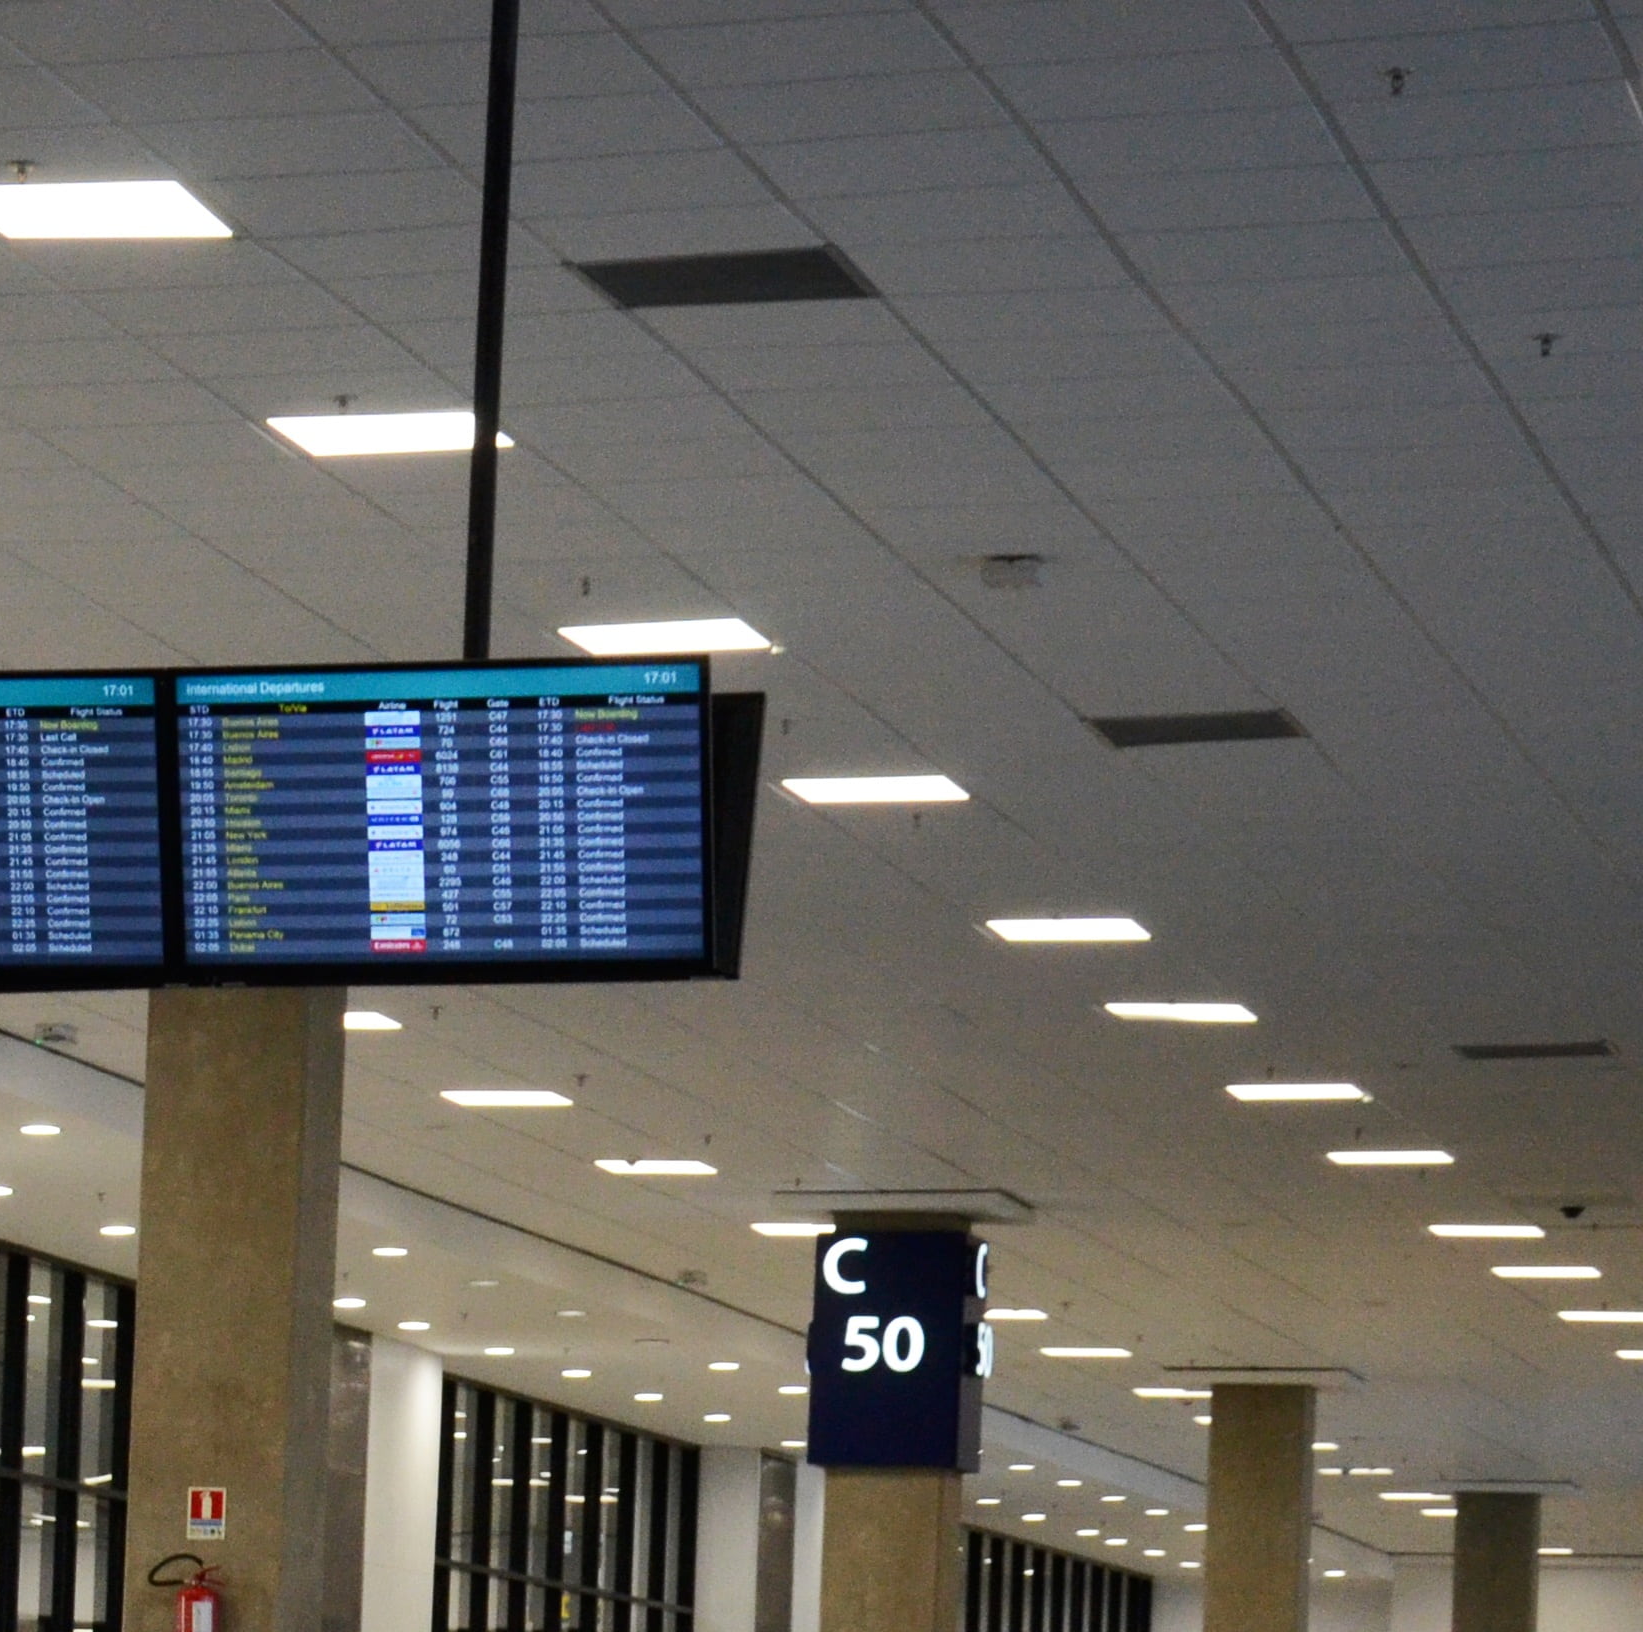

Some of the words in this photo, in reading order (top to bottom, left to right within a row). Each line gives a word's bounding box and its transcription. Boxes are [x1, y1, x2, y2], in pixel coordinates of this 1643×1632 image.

[643, 670, 677, 684] 17:01
[103, 684, 134, 697] 17:01
[186, 682, 257, 697] International
[259, 680, 325, 698] Departures
[487, 698, 509, 708] Gate
[539, 698, 560, 707] ETD
[607, 695, 633, 706] Flight
[635, 694, 665, 704] Status
[189, 704, 209, 714] STD
[379, 701, 407, 711] Airline
[433, 700, 459, 712] Flight
[5, 708, 25, 717] ETD
[70, 707, 93, 718] Flight
[95, 707, 123, 716] Status
[575, 709, 596, 719] Now
[40, 720, 59, 731] Now
[40, 732, 59, 743] Last
[61, 732, 77, 743] Call
[575, 734, 615, 745] Check-in
[617, 733, 649, 744] Closed
[41, 745, 78, 755] Check-in
[80, 744, 109, 755] Closed
[576, 747, 622, 757] Confirmed
[41, 757, 84, 768] Confirmed
[576, 759, 623, 770] Scheduled
[42, 769, 85, 780] Scheduled
[577, 772, 622, 783] Confirmed
[42, 782, 85, 792] Confirmed
[577, 785, 616, 796] Check-in
[619, 784, 643, 797] Open
[43, 794, 80, 805] Check-in
[82, 794, 105, 806] Open
[577, 798, 623, 808] Confirmed
[43, 806, 86, 817] Confirmed
[577, 811, 623, 821] Confirmed
[44, 819, 86, 829] Confirmed
[578, 823, 623, 834] Confirmed
[44, 831, 87, 842] Confirmed
[578, 836, 624, 847] Confirmed
[45, 843, 87, 854] Confirmed
[578, 849, 624, 859] Confirmed
[45, 856, 88, 866] Confirmed
[578, 862, 624, 872] Confirmed
[46, 868, 88, 879] Confirmed
[579, 874, 625, 885] Scheduled
[46, 881, 89, 891] Scheduled
[47, 893, 89, 903] Confirmed
[579, 887, 625, 898] Confirmed
[47, 905, 90, 916] Confirmed
[579, 900, 625, 910] Confirmed
[48, 918, 90, 928] Confirmed
[579, 913, 625, 923] Confirmed
[48, 930, 91, 941] Scheduled
[580, 925, 626, 936] Scheduled
[49, 942, 92, 953] Scheduled
[580, 938, 626, 949] Scheduled
[822, 1237, 868, 1294] C
[841, 1315, 925, 1372] 50
